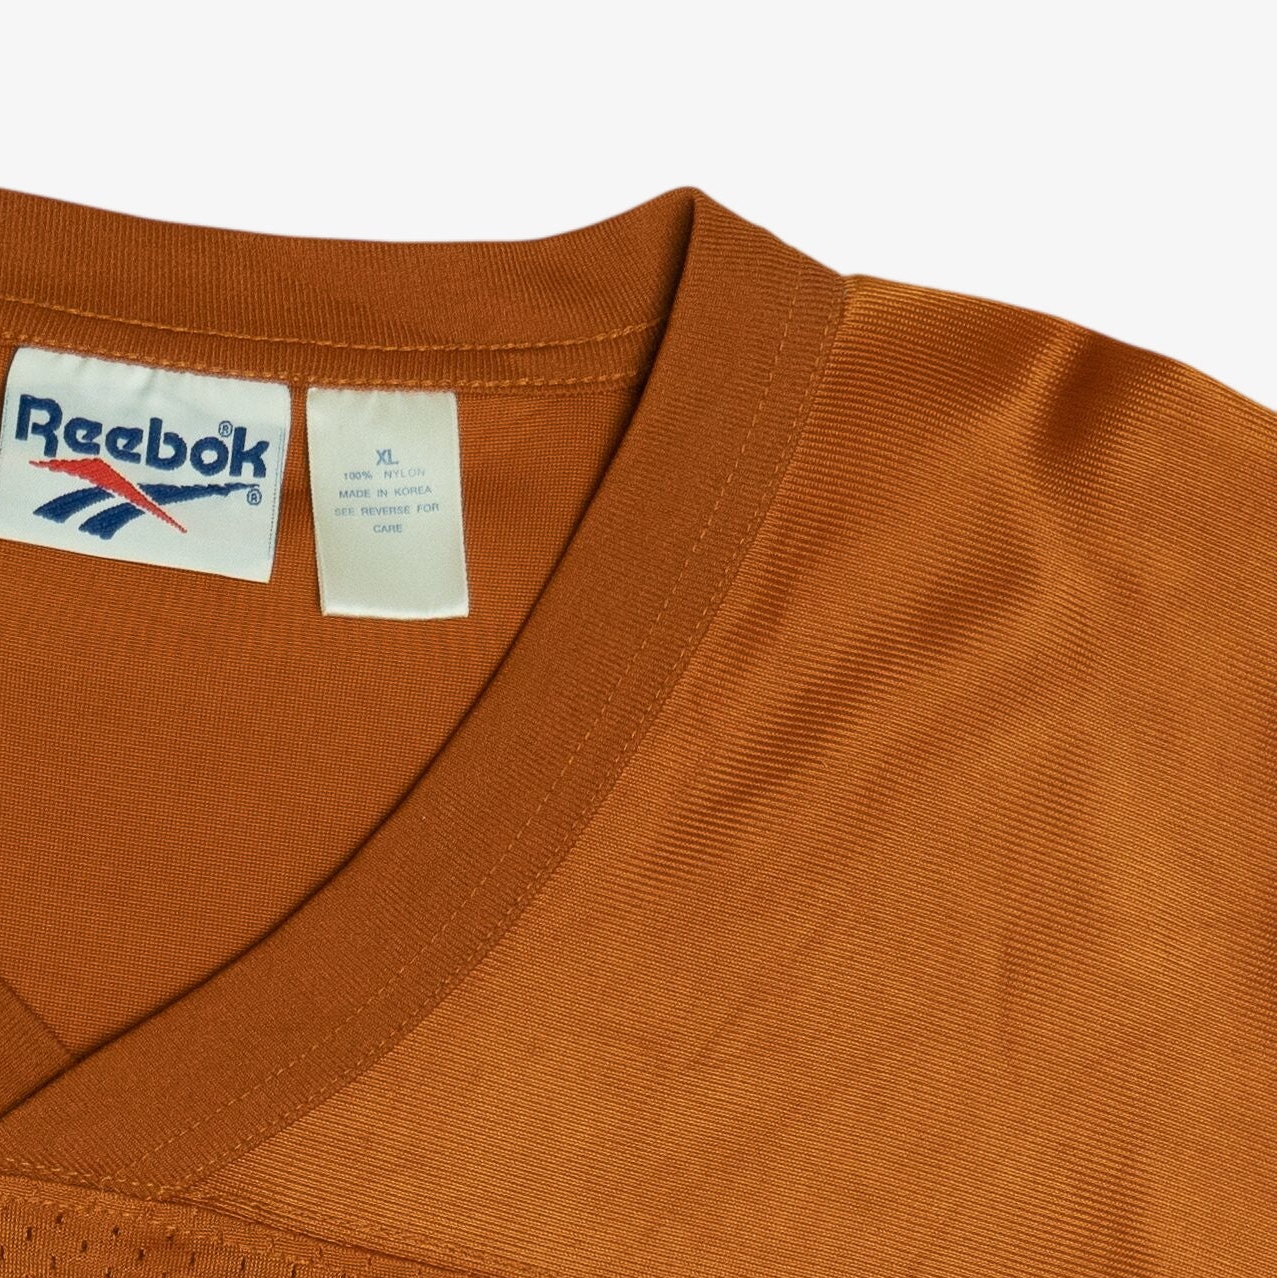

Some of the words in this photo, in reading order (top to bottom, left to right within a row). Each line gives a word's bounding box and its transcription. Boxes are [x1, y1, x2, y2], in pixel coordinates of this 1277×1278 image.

[15, 394, 270, 478] Reebok
[375, 448, 399, 466] XL
[344, 470, 373, 480] 100%
[383, 468, 425, 479] NYLON
[339, 489, 371, 499] MADE
[377, 489, 388, 498] IN
[394, 485, 433, 497] KOREA
[334, 507, 355, 517] SEE
[361, 505, 411, 516] REVERSE
[417, 503, 440, 513] FOR
[373, 524, 403, 534] CARE
